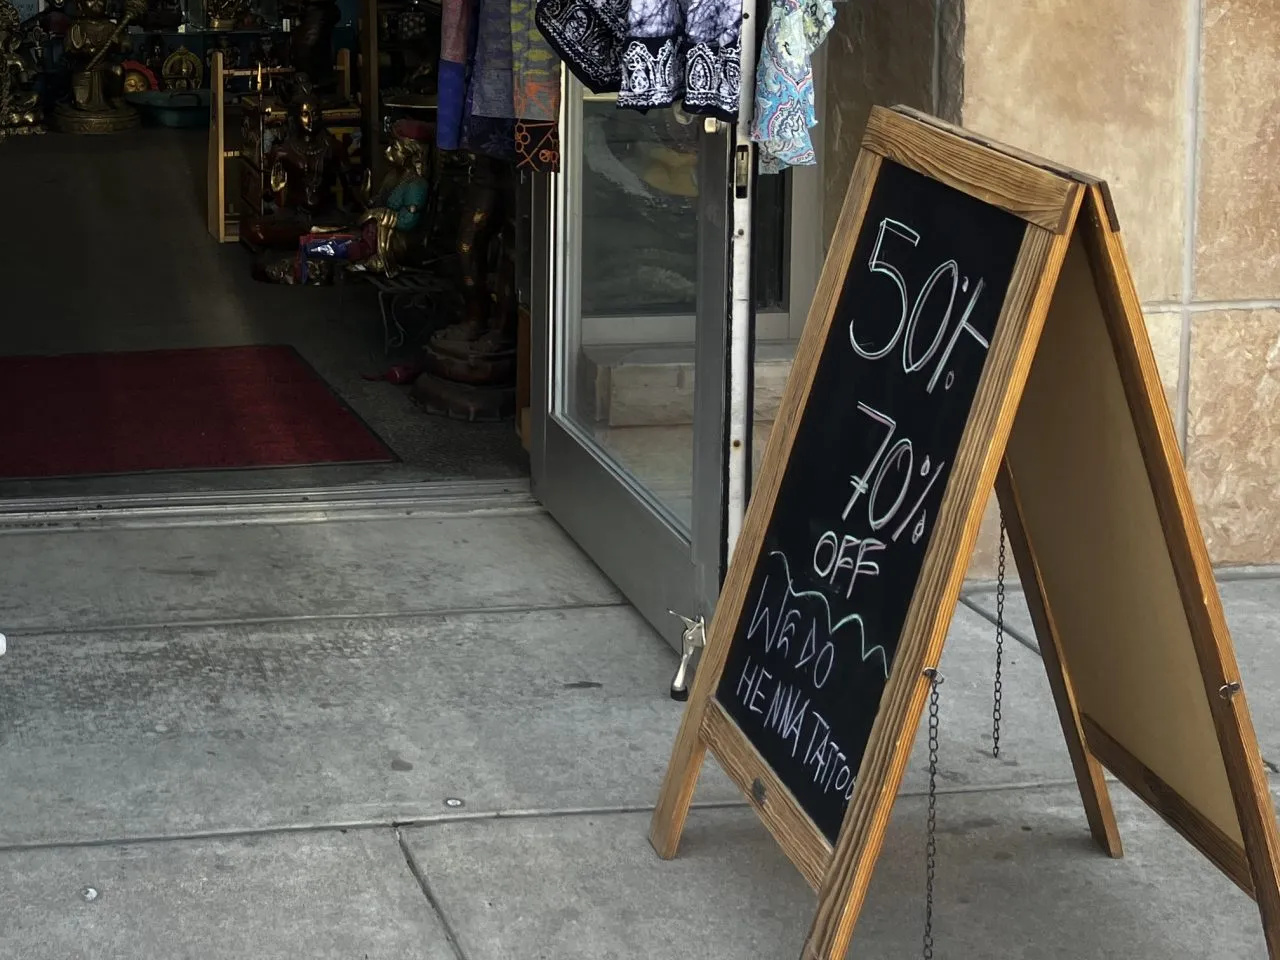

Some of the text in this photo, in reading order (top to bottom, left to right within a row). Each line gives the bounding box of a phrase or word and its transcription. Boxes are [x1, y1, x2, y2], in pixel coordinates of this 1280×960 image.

[849, 217, 990, 394] 50%
[842, 400, 945, 544] 70%
[813, 530, 887, 599] OFF
[795, 616, 834, 689] DO
[736, 656, 810, 758] HENNA
